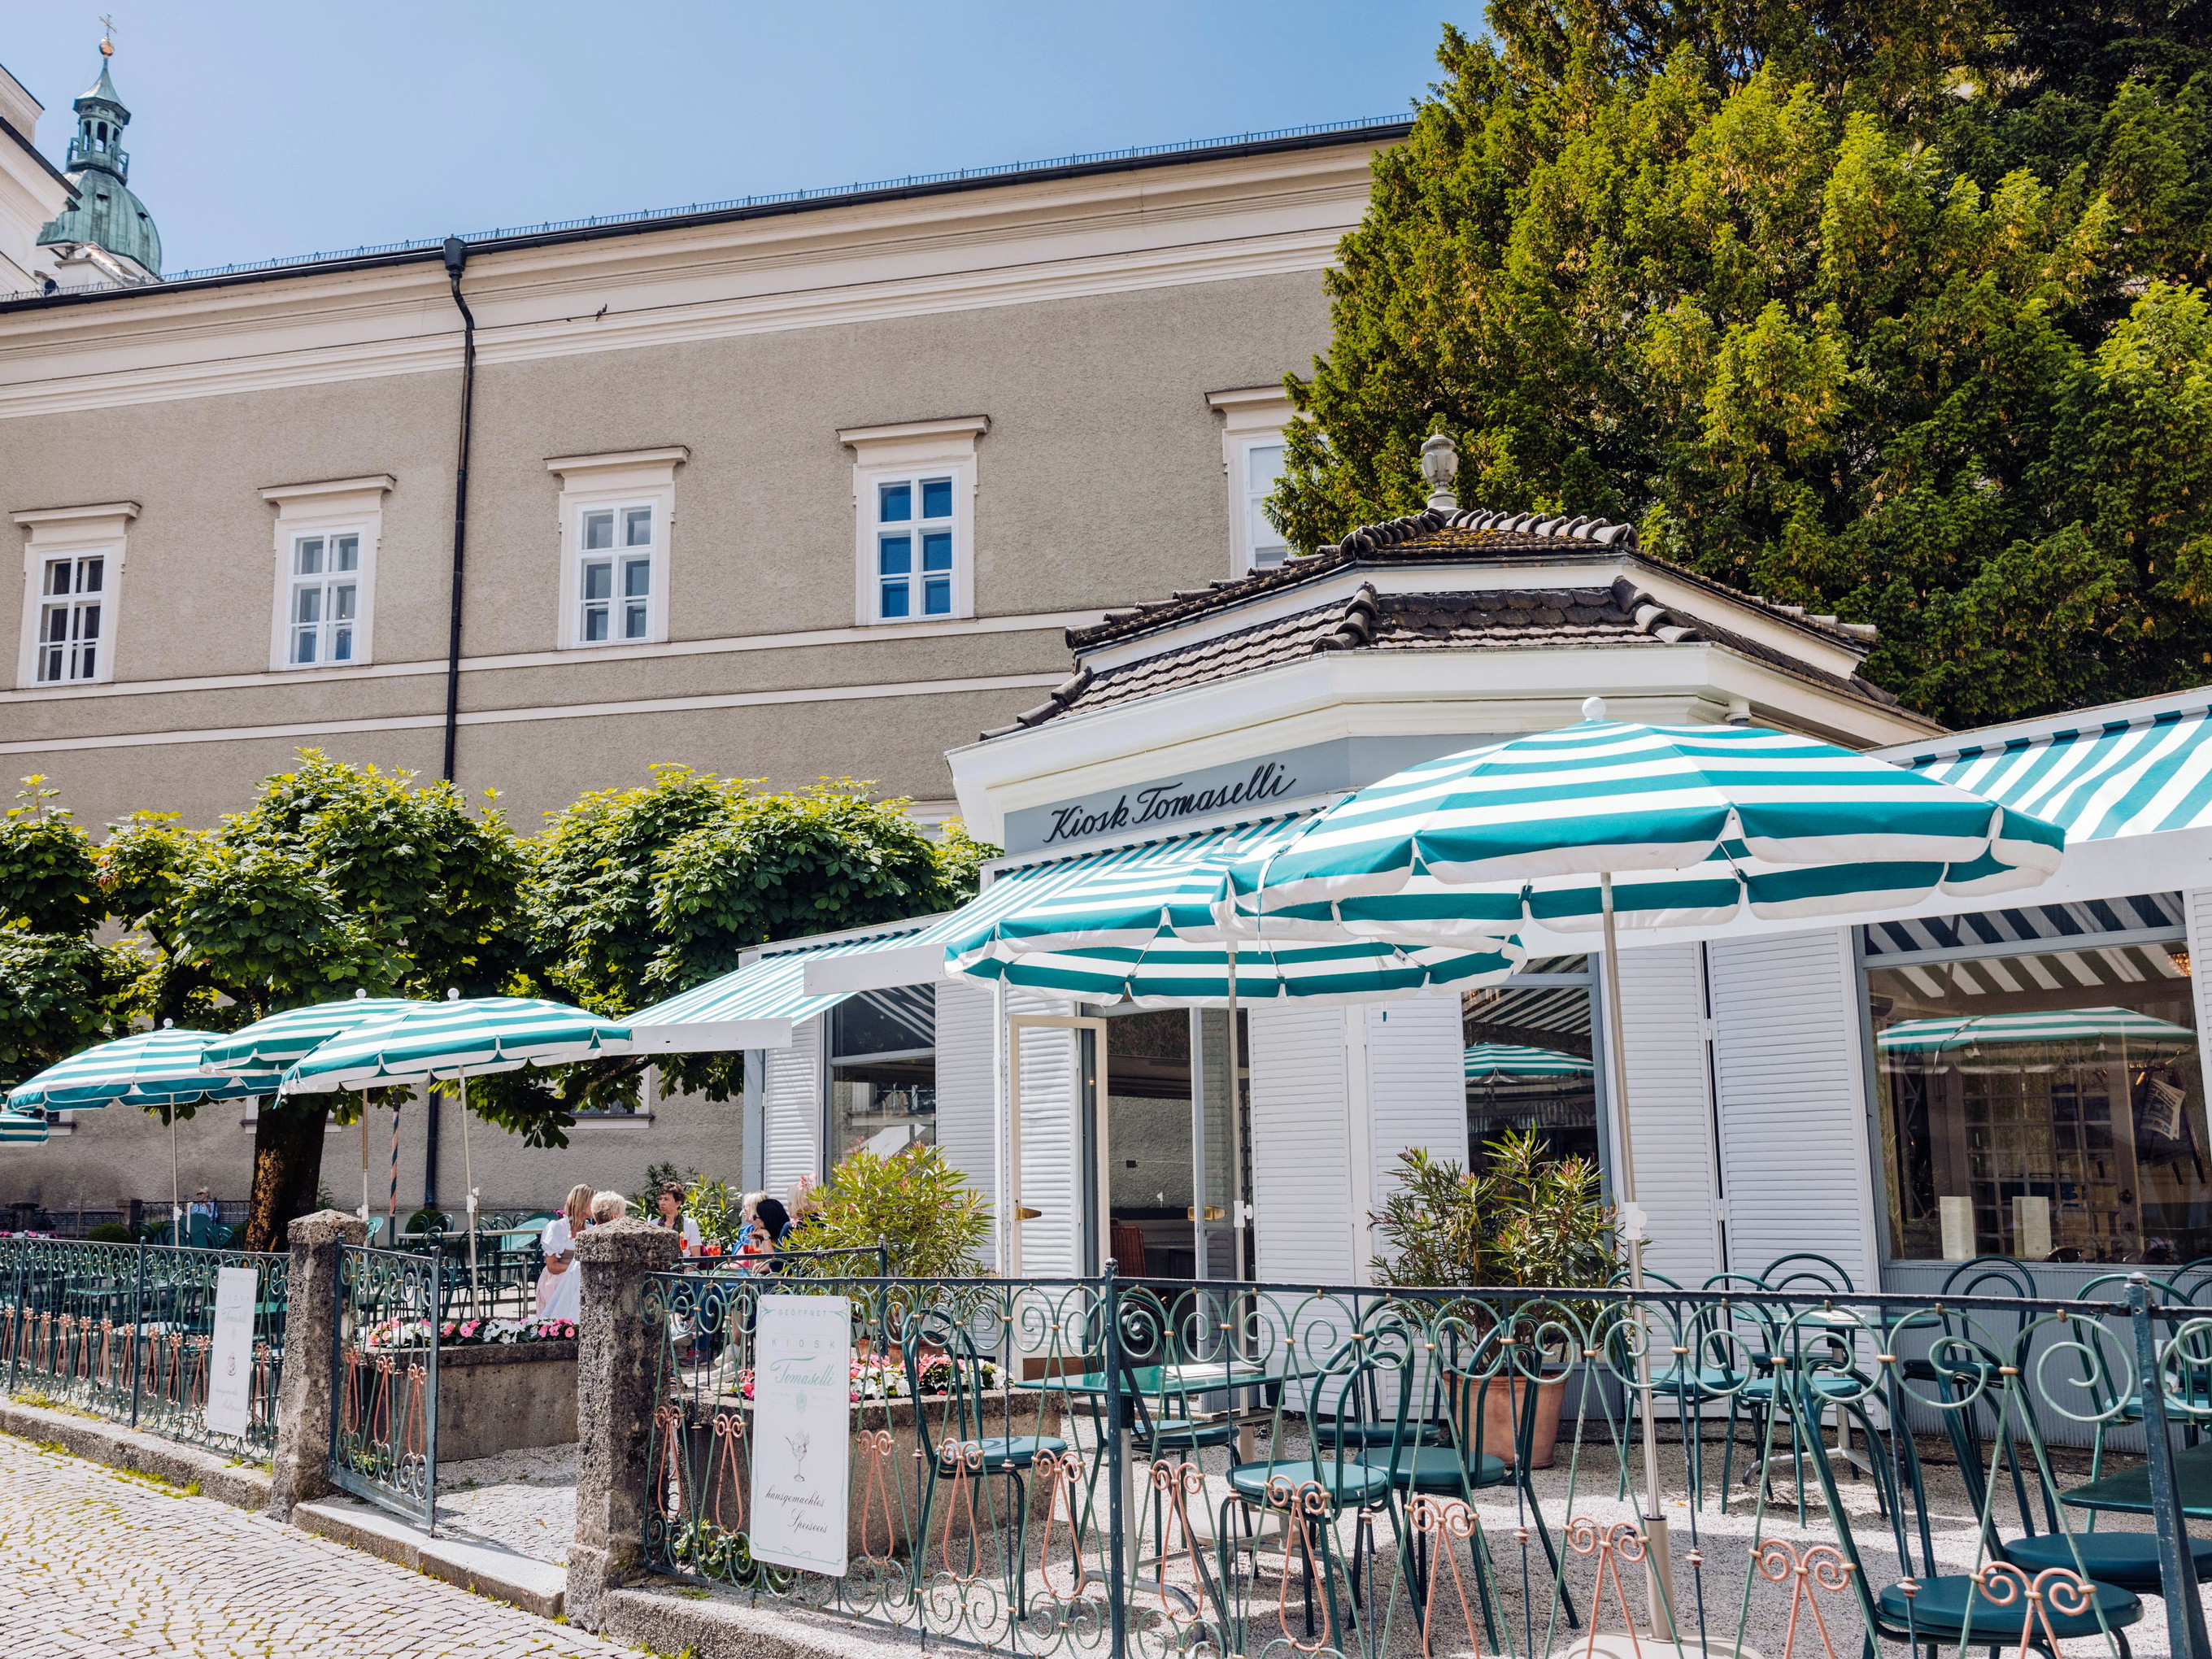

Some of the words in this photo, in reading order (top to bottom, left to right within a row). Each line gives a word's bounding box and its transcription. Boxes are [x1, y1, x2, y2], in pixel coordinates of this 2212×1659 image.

[1043, 795, 1130, 843] Kiosk
[1131, 761, 1297, 825] Tomaselli
[777, 1308, 827, 1317] GEÖFFNET
[772, 1338, 836, 1349] KIOSK
[769, 1355, 838, 1387] Tomaselli
[765, 1483, 825, 1508] hausgemachtes
[787, 1508, 828, 1534] Speiseeis
